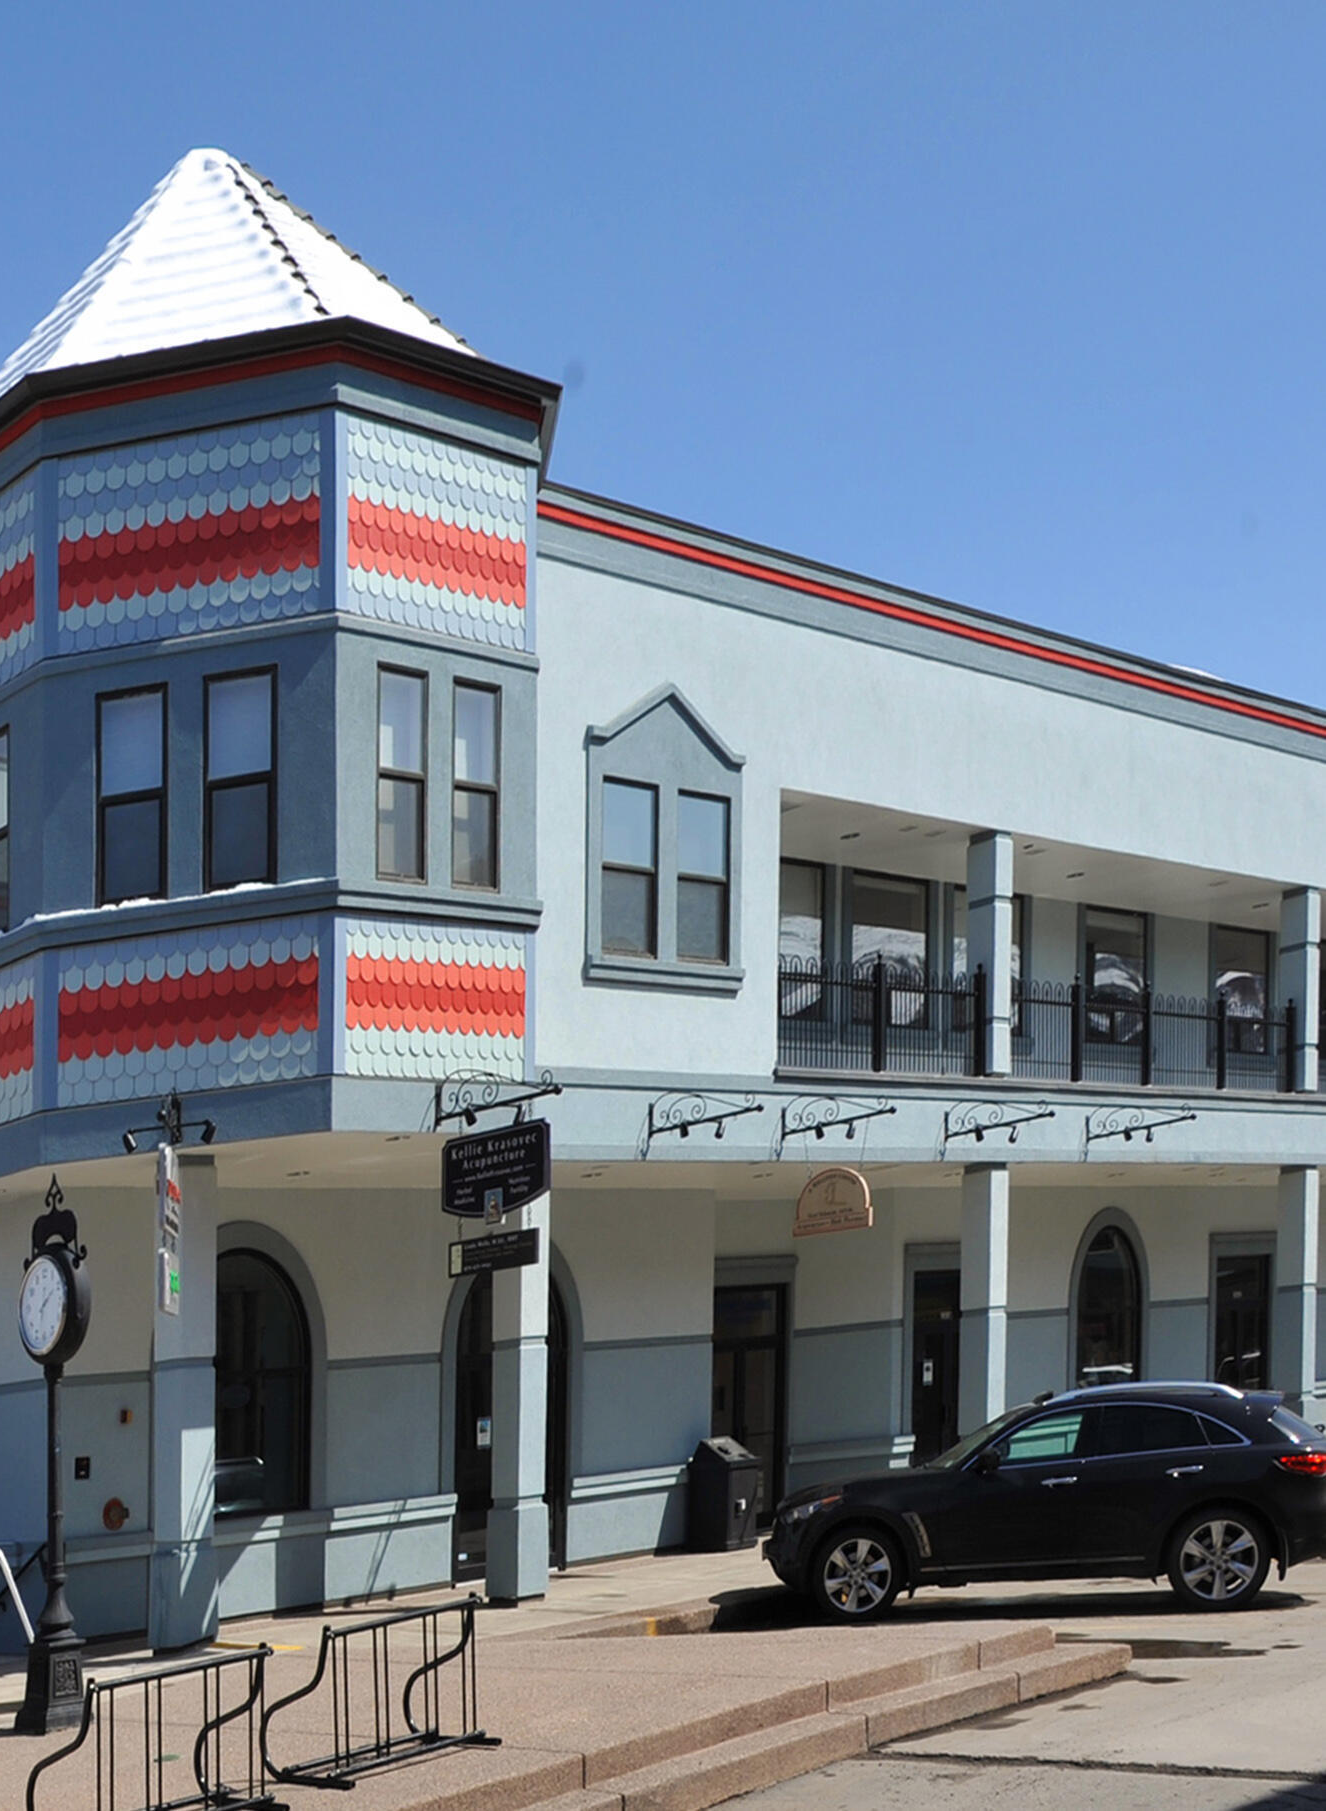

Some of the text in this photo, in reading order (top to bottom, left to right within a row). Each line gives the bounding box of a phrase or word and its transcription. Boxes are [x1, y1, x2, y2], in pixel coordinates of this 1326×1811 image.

[451, 1132, 538, 1160] Kellie Krasovec
[462, 1149, 526, 1170] Acupuncture
